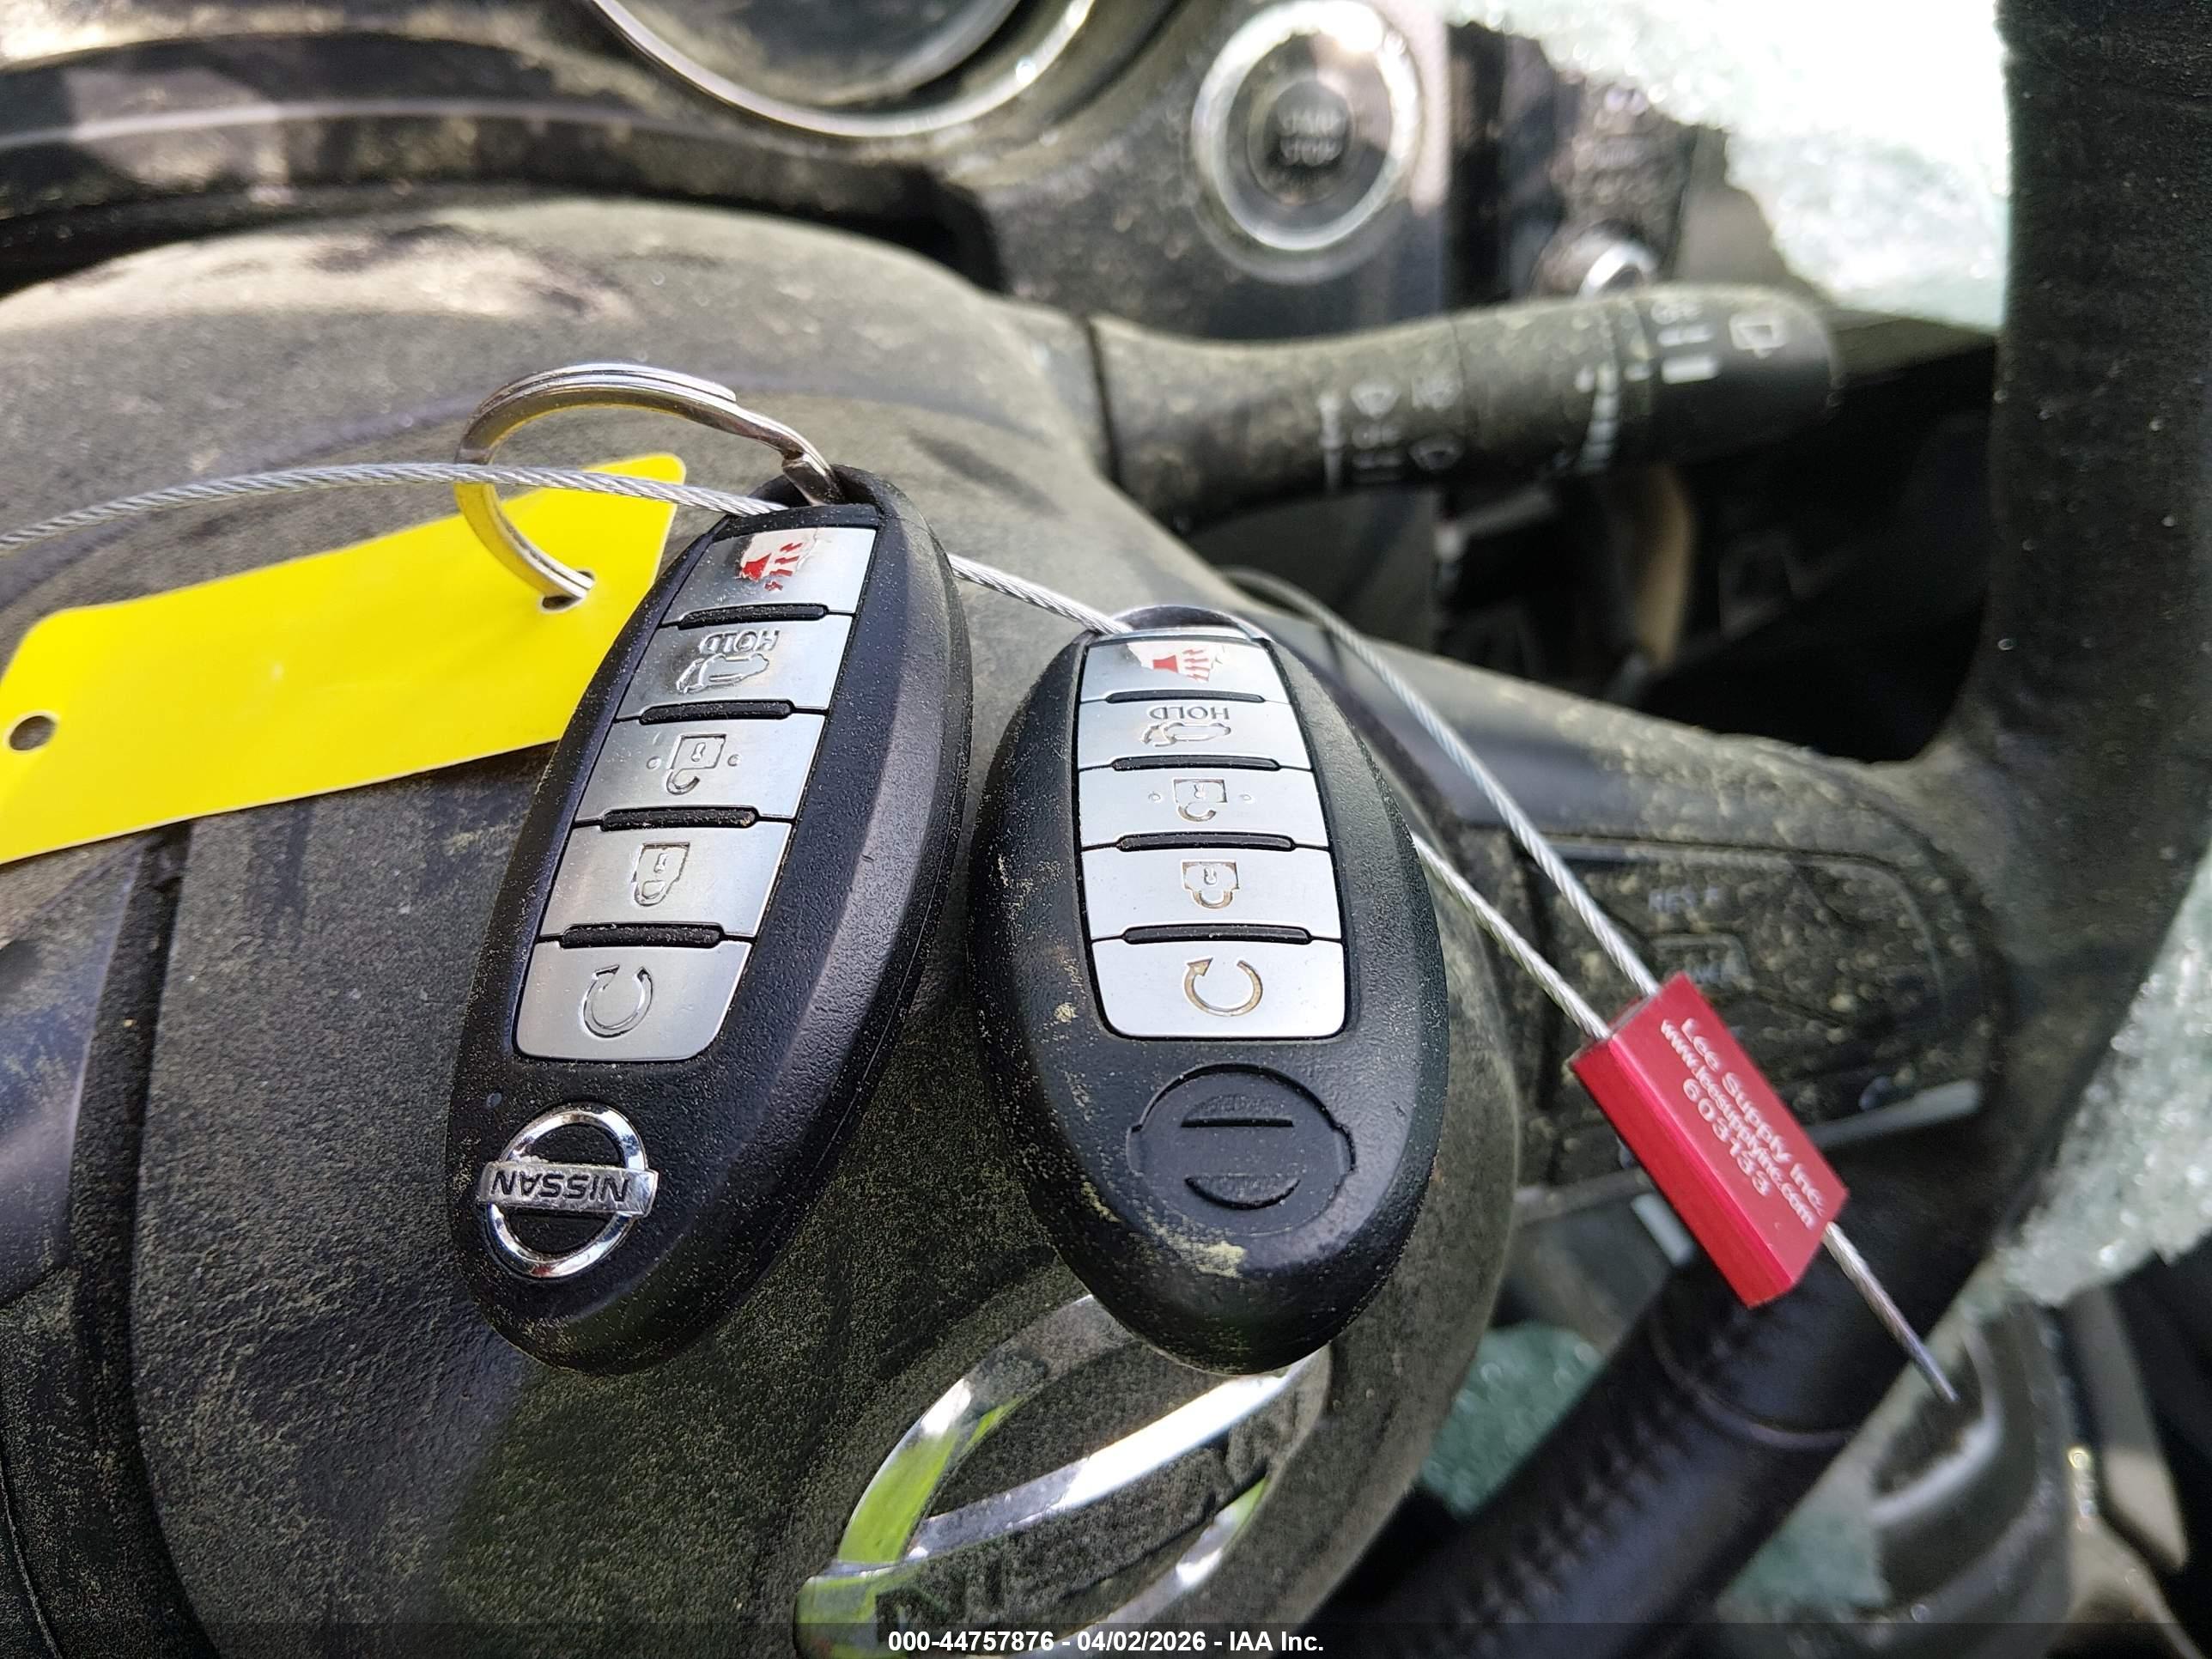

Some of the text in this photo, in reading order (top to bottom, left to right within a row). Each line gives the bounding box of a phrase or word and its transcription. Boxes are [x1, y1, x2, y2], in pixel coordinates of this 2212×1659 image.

[699, 629, 781, 654] HOLD
[1148, 705, 1231, 720] HOLD
[1680, 1017, 1721, 1073] Lee
[1722, 1072, 1792, 1163] Supply
[1682, 1078, 1771, 1197] 603133
[489, 1169, 630, 1203] NISSAN
